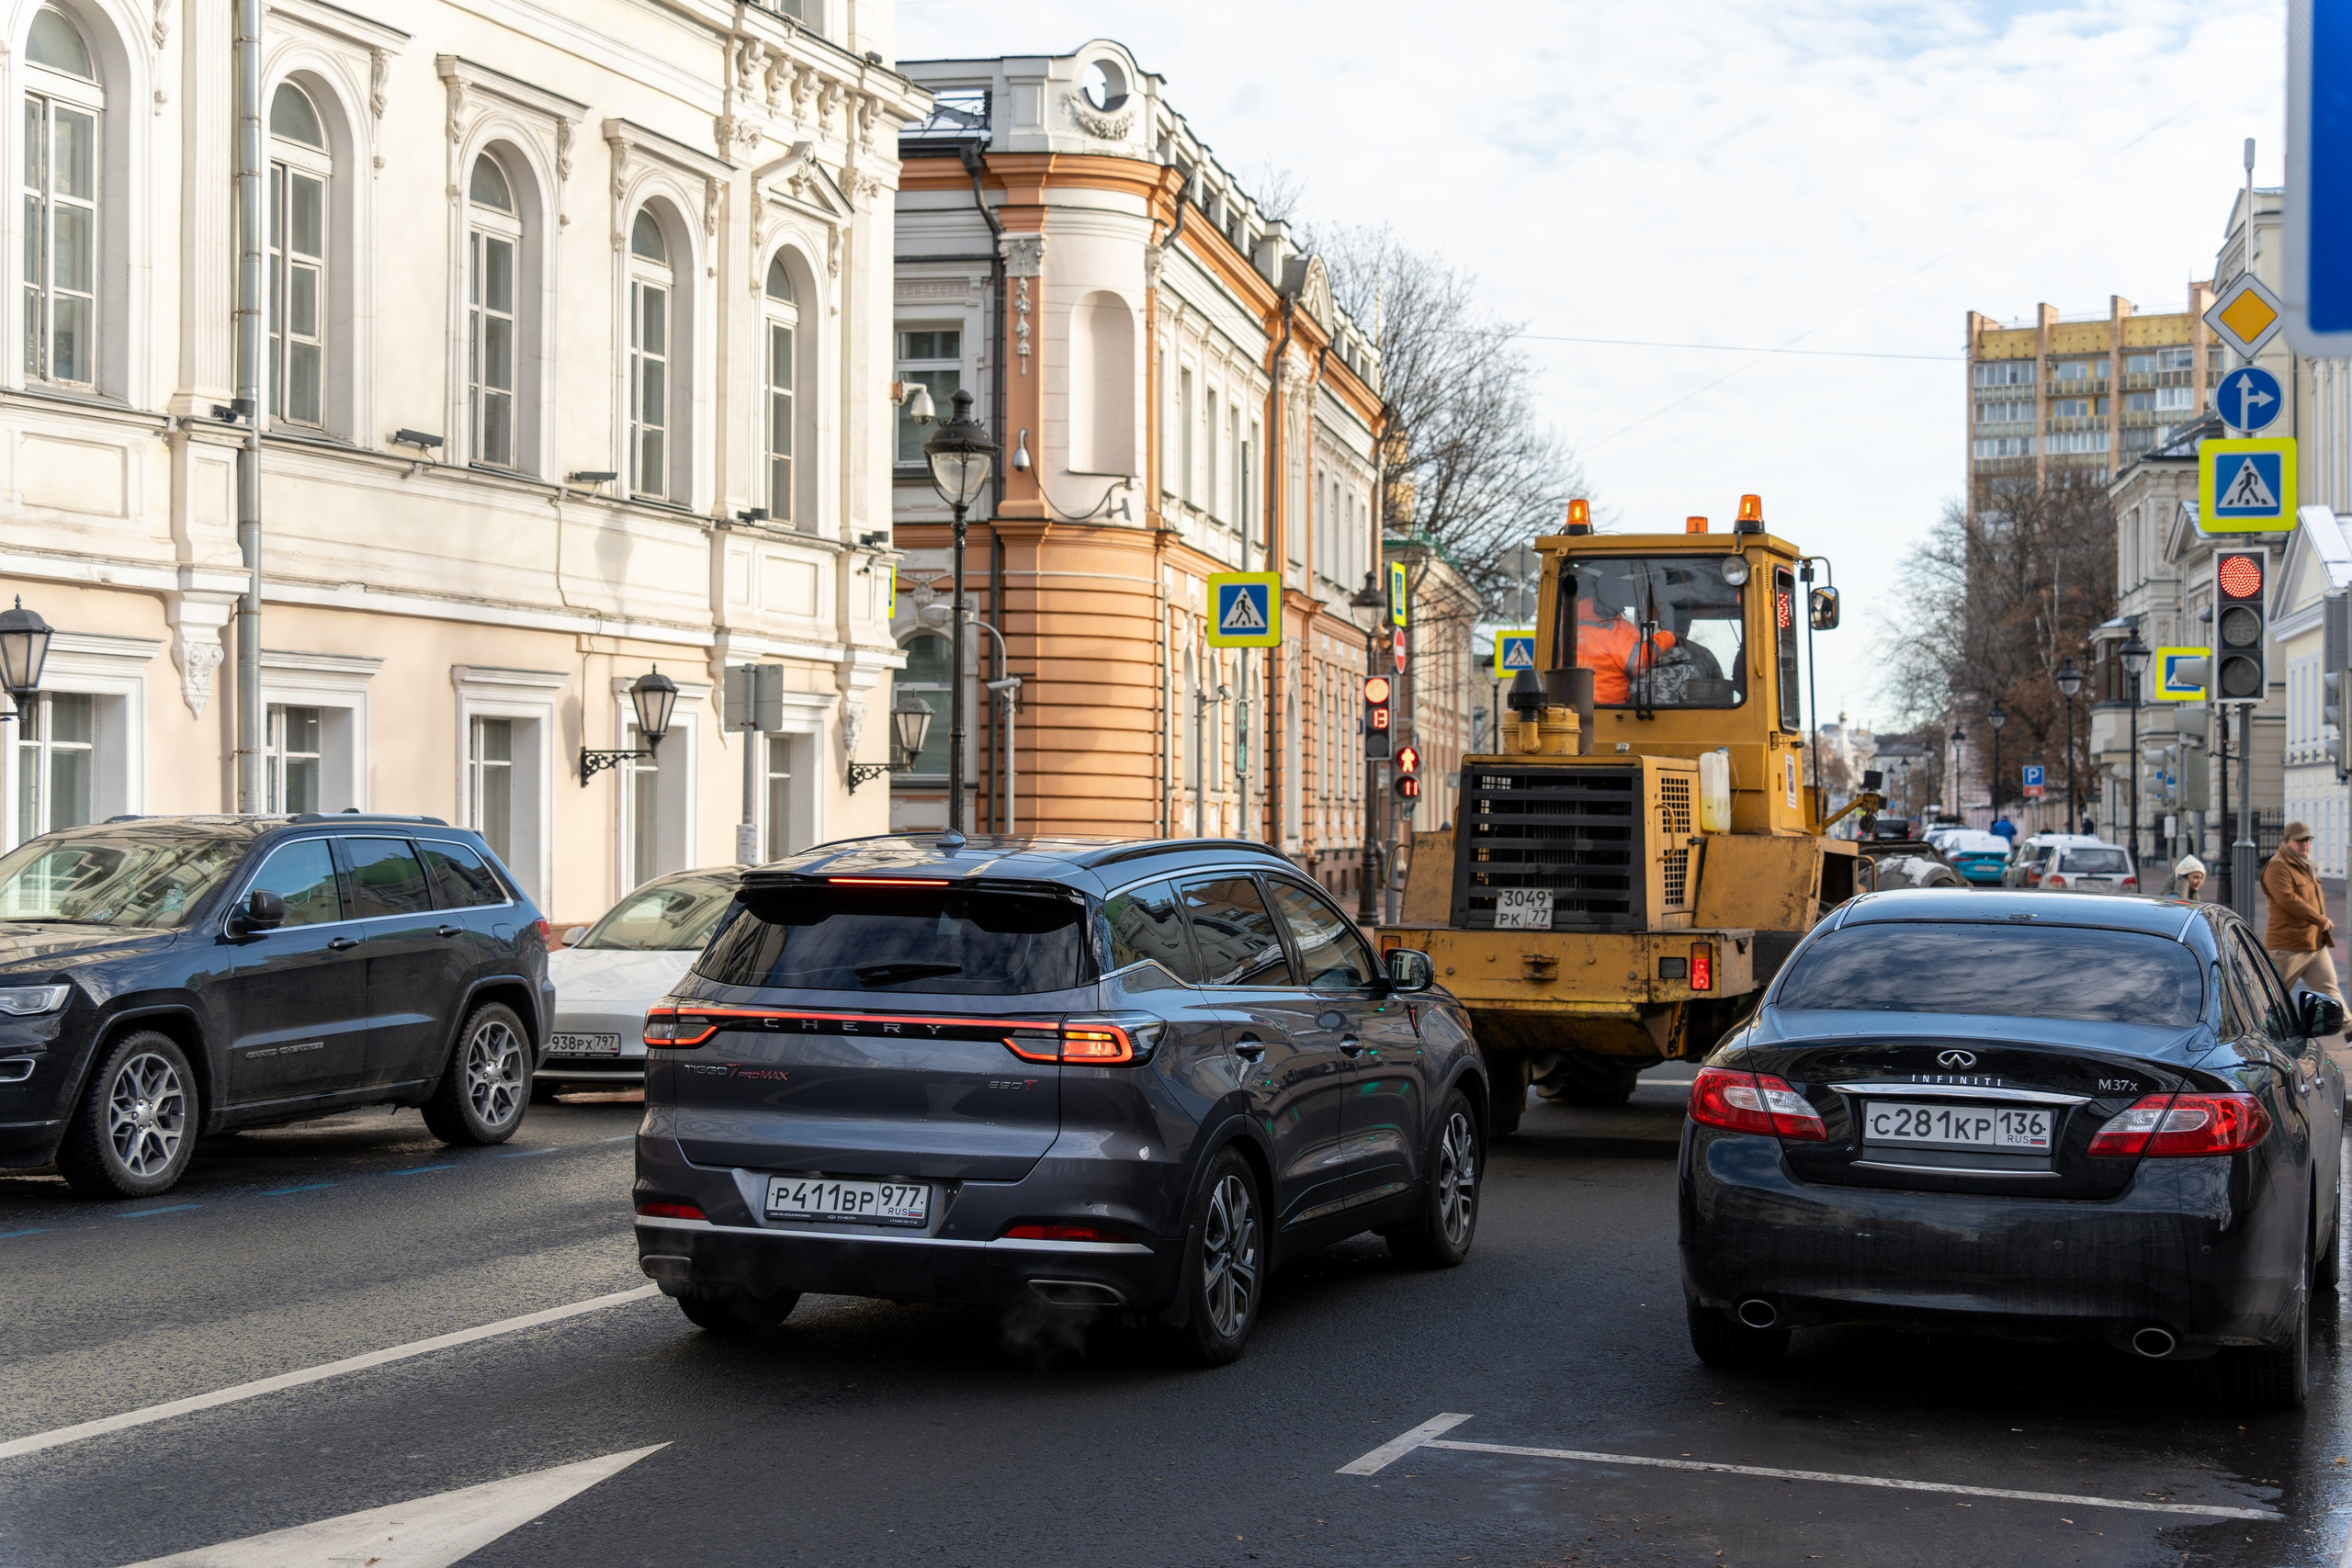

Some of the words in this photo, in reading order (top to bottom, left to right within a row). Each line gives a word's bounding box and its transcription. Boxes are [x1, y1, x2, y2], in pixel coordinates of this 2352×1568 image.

[1374, 708, 1388, 728] 13
[2028, 768, 2040, 784] P
[1406, 781, 1419, 796] 11
[1504, 890, 1546, 907] 3049
[1499, 913, 1521, 926] РК
[1532, 909, 1548, 922] 77
[763, 1018, 942, 1035] CHERY
[551, 1035, 594, 1051] 938РХ
[595, 1035, 615, 1047] 797
[989, 1078, 1039, 1091] 290T
[1912, 1074, 2001, 1087] INFINITI
[2098, 1078, 2139, 1091] M37x
[1873, 1108, 1991, 1140] С281КР
[1998, 1111, 2043, 1135] 136
[2007, 1134, 2030, 1144] RUS
[775, 1182, 874, 1213] Р411ВР
[880, 1185, 922, 1208] 977
[888, 1207, 908, 1216] RUS
